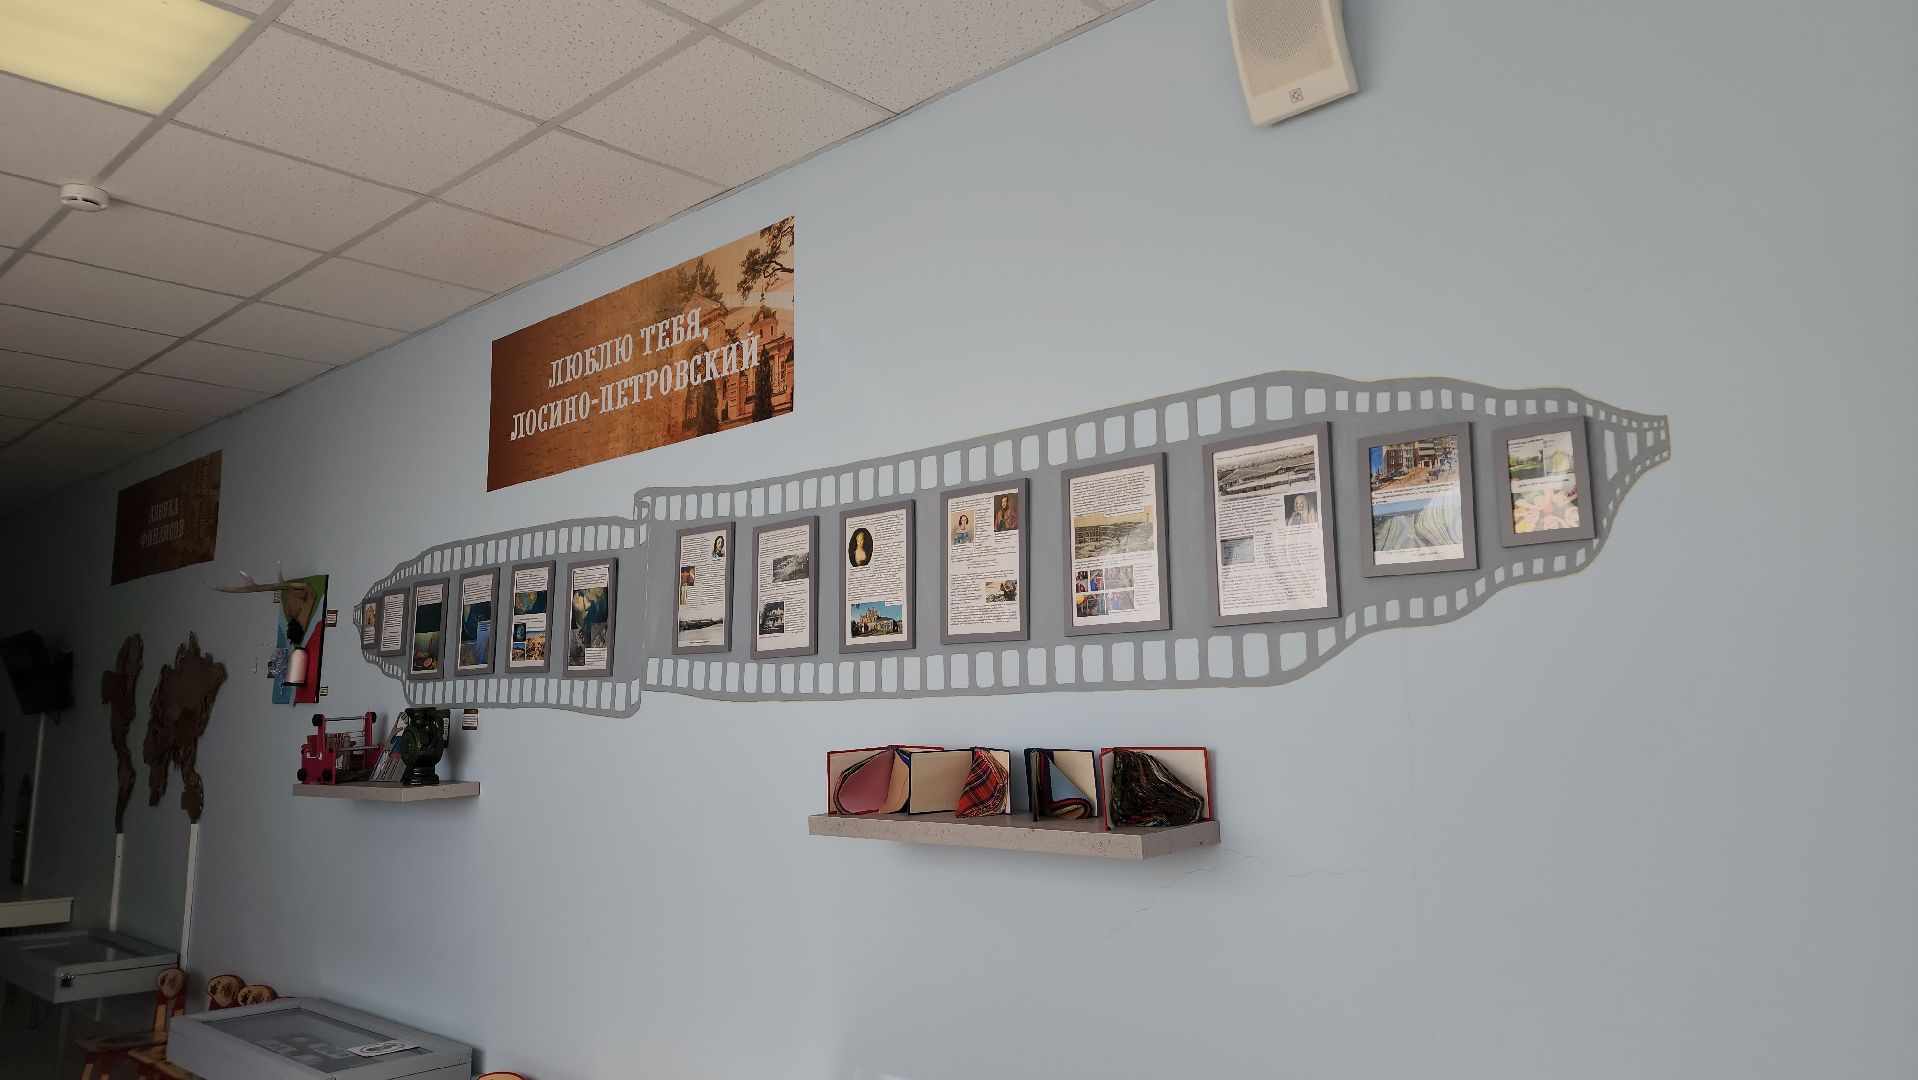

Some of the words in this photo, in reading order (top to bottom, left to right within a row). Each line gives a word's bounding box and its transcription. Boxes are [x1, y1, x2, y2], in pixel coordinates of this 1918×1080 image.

[510, 331, 760, 441] ЛОСИНО-ПЕТРОВСКИЙ
[548, 333, 633, 389] ЛЮБЛЮ
[640, 307, 709, 356] ТЕБЯ,
